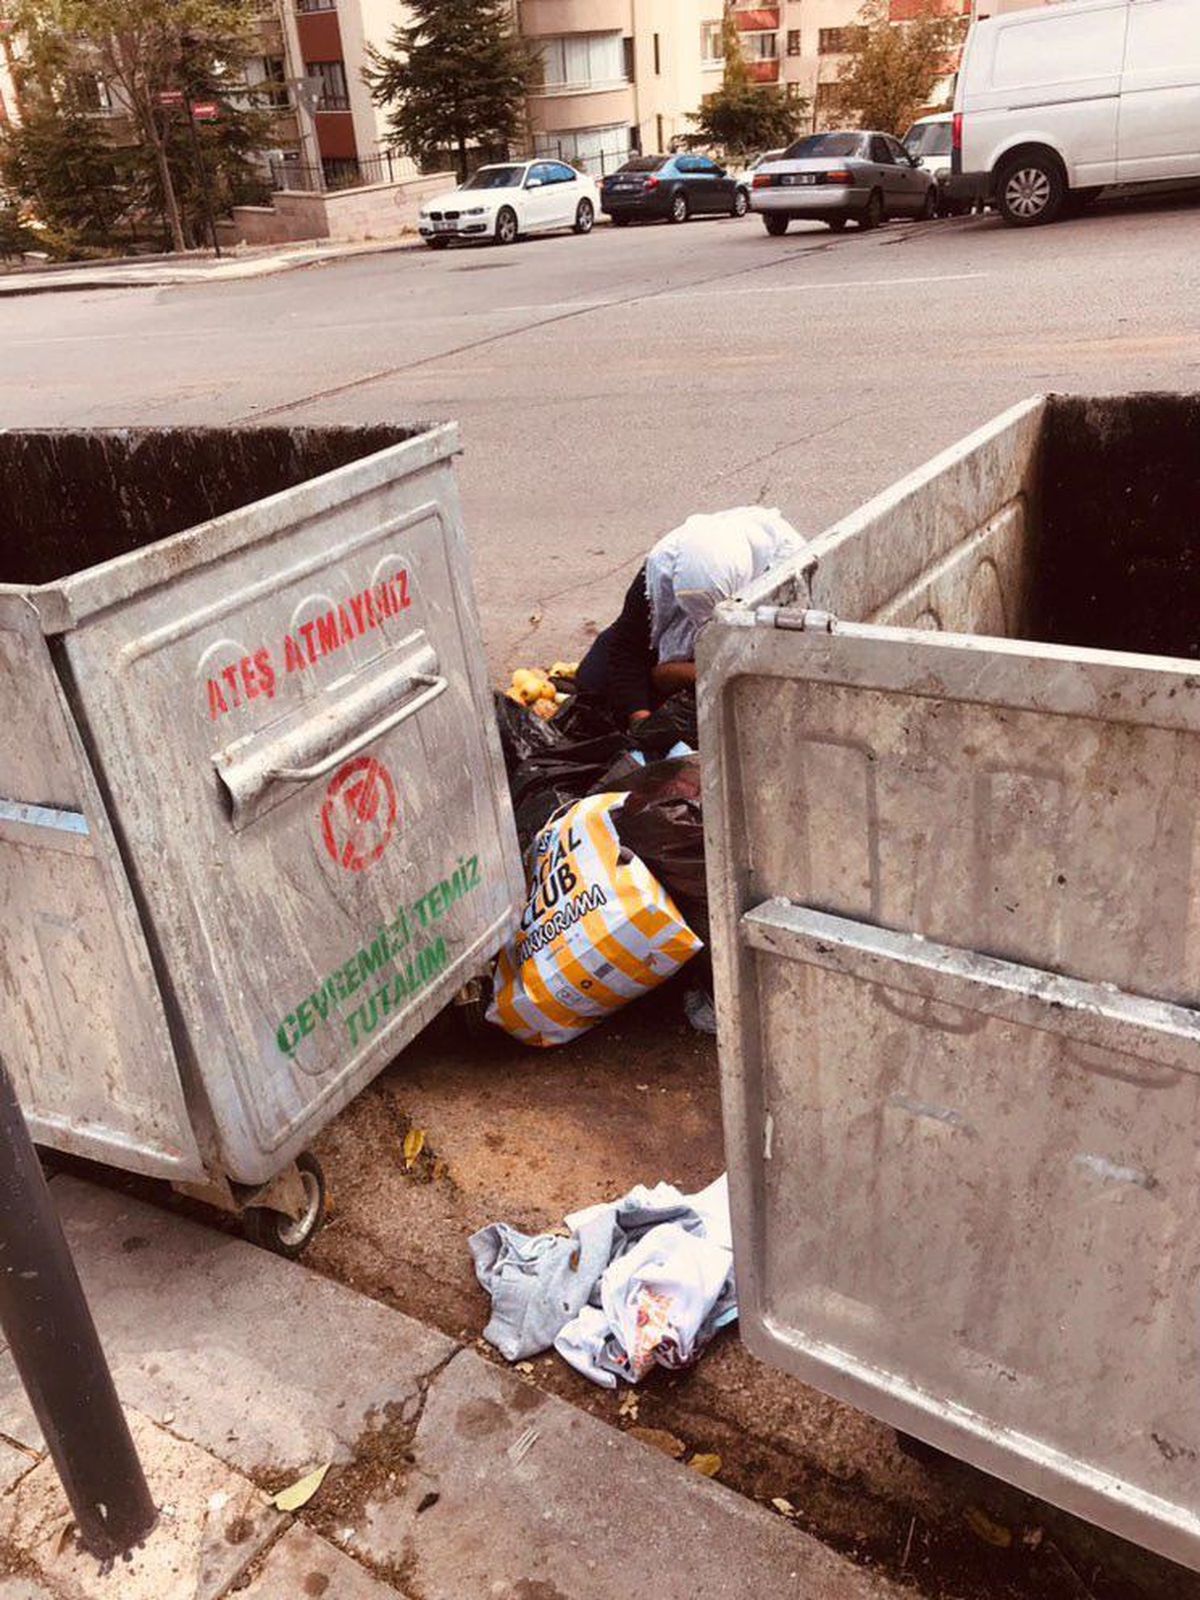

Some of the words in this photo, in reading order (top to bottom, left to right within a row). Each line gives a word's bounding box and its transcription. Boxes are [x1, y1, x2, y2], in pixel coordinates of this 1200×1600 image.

[206, 647, 276, 721] ATEŞ
[284, 569, 413, 673] ATMAYINIZ
[411, 853, 482, 928] TEMİZ
[345, 935, 448, 1049] TUTALIM
